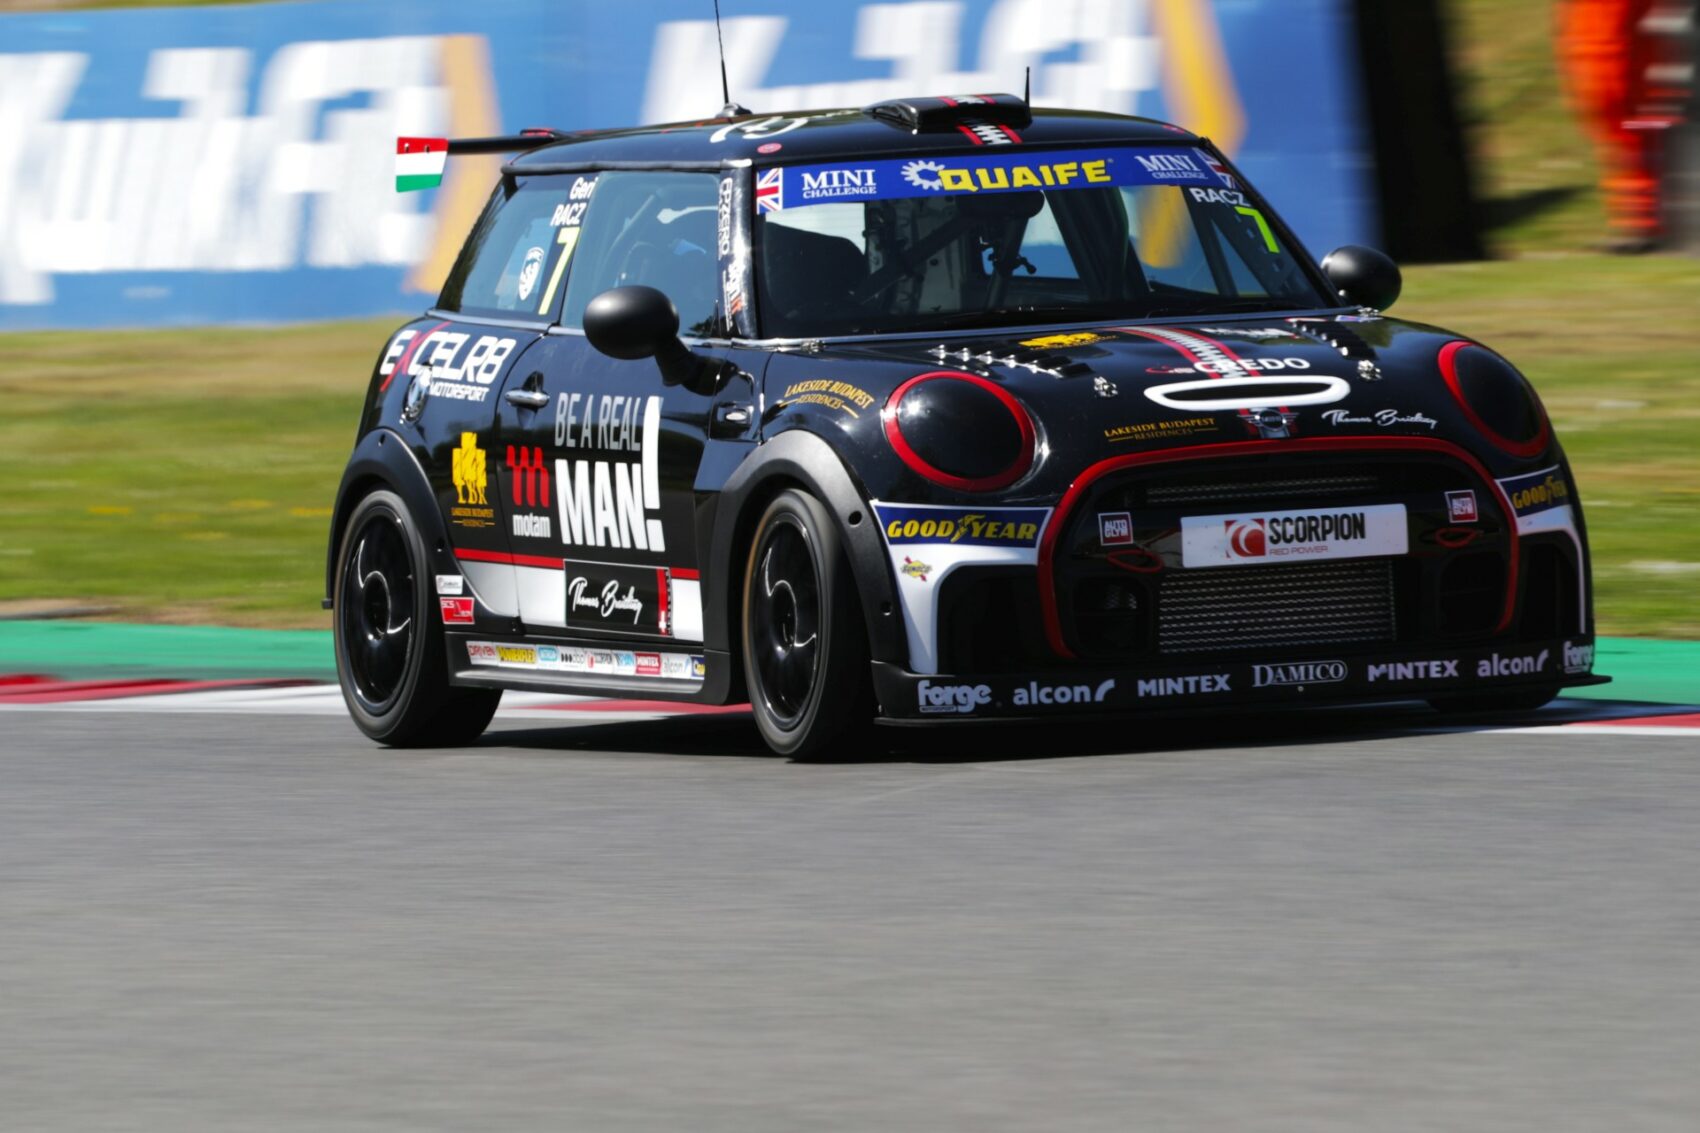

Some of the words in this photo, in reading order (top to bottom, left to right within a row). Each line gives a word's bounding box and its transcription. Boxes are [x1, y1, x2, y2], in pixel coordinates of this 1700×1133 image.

[1134, 155, 1200, 172] MINI
[802, 169, 876, 191] MINI
[938, 160, 1111, 192] QUAIFE
[803, 187, 877, 199] CHALLENGE
[1189, 188, 1251, 207] RACZ
[550, 203, 587, 226] RACZ
[1234, 206, 1280, 253] 7
[538, 226, 581, 315] 7
[1194, 357, 1310, 373] CREDO
[430, 381, 490, 402] MOTORSPORT
[555, 392, 581, 448] BE
[581, 394, 593, 448] A
[598, 395, 641, 451] REAL
[1104, 423, 1156, 437] LAKESIDE
[1159, 418, 1215, 429] BUDAPEST
[512, 512, 551, 538] motam
[1269, 512, 1366, 544] SCORPION
[1270, 548, 1289, 556] RED
[1291, 545, 1328, 554] POWER
[1252, 663, 1346, 687] DAMICO
[1367, 660, 1459, 682] MINTEX
[1477, 653, 1534, 677] alcon
[918, 680, 992, 712] forge
[1013, 681, 1092, 705] alcon
[1137, 674, 1232, 697] MINTEX
